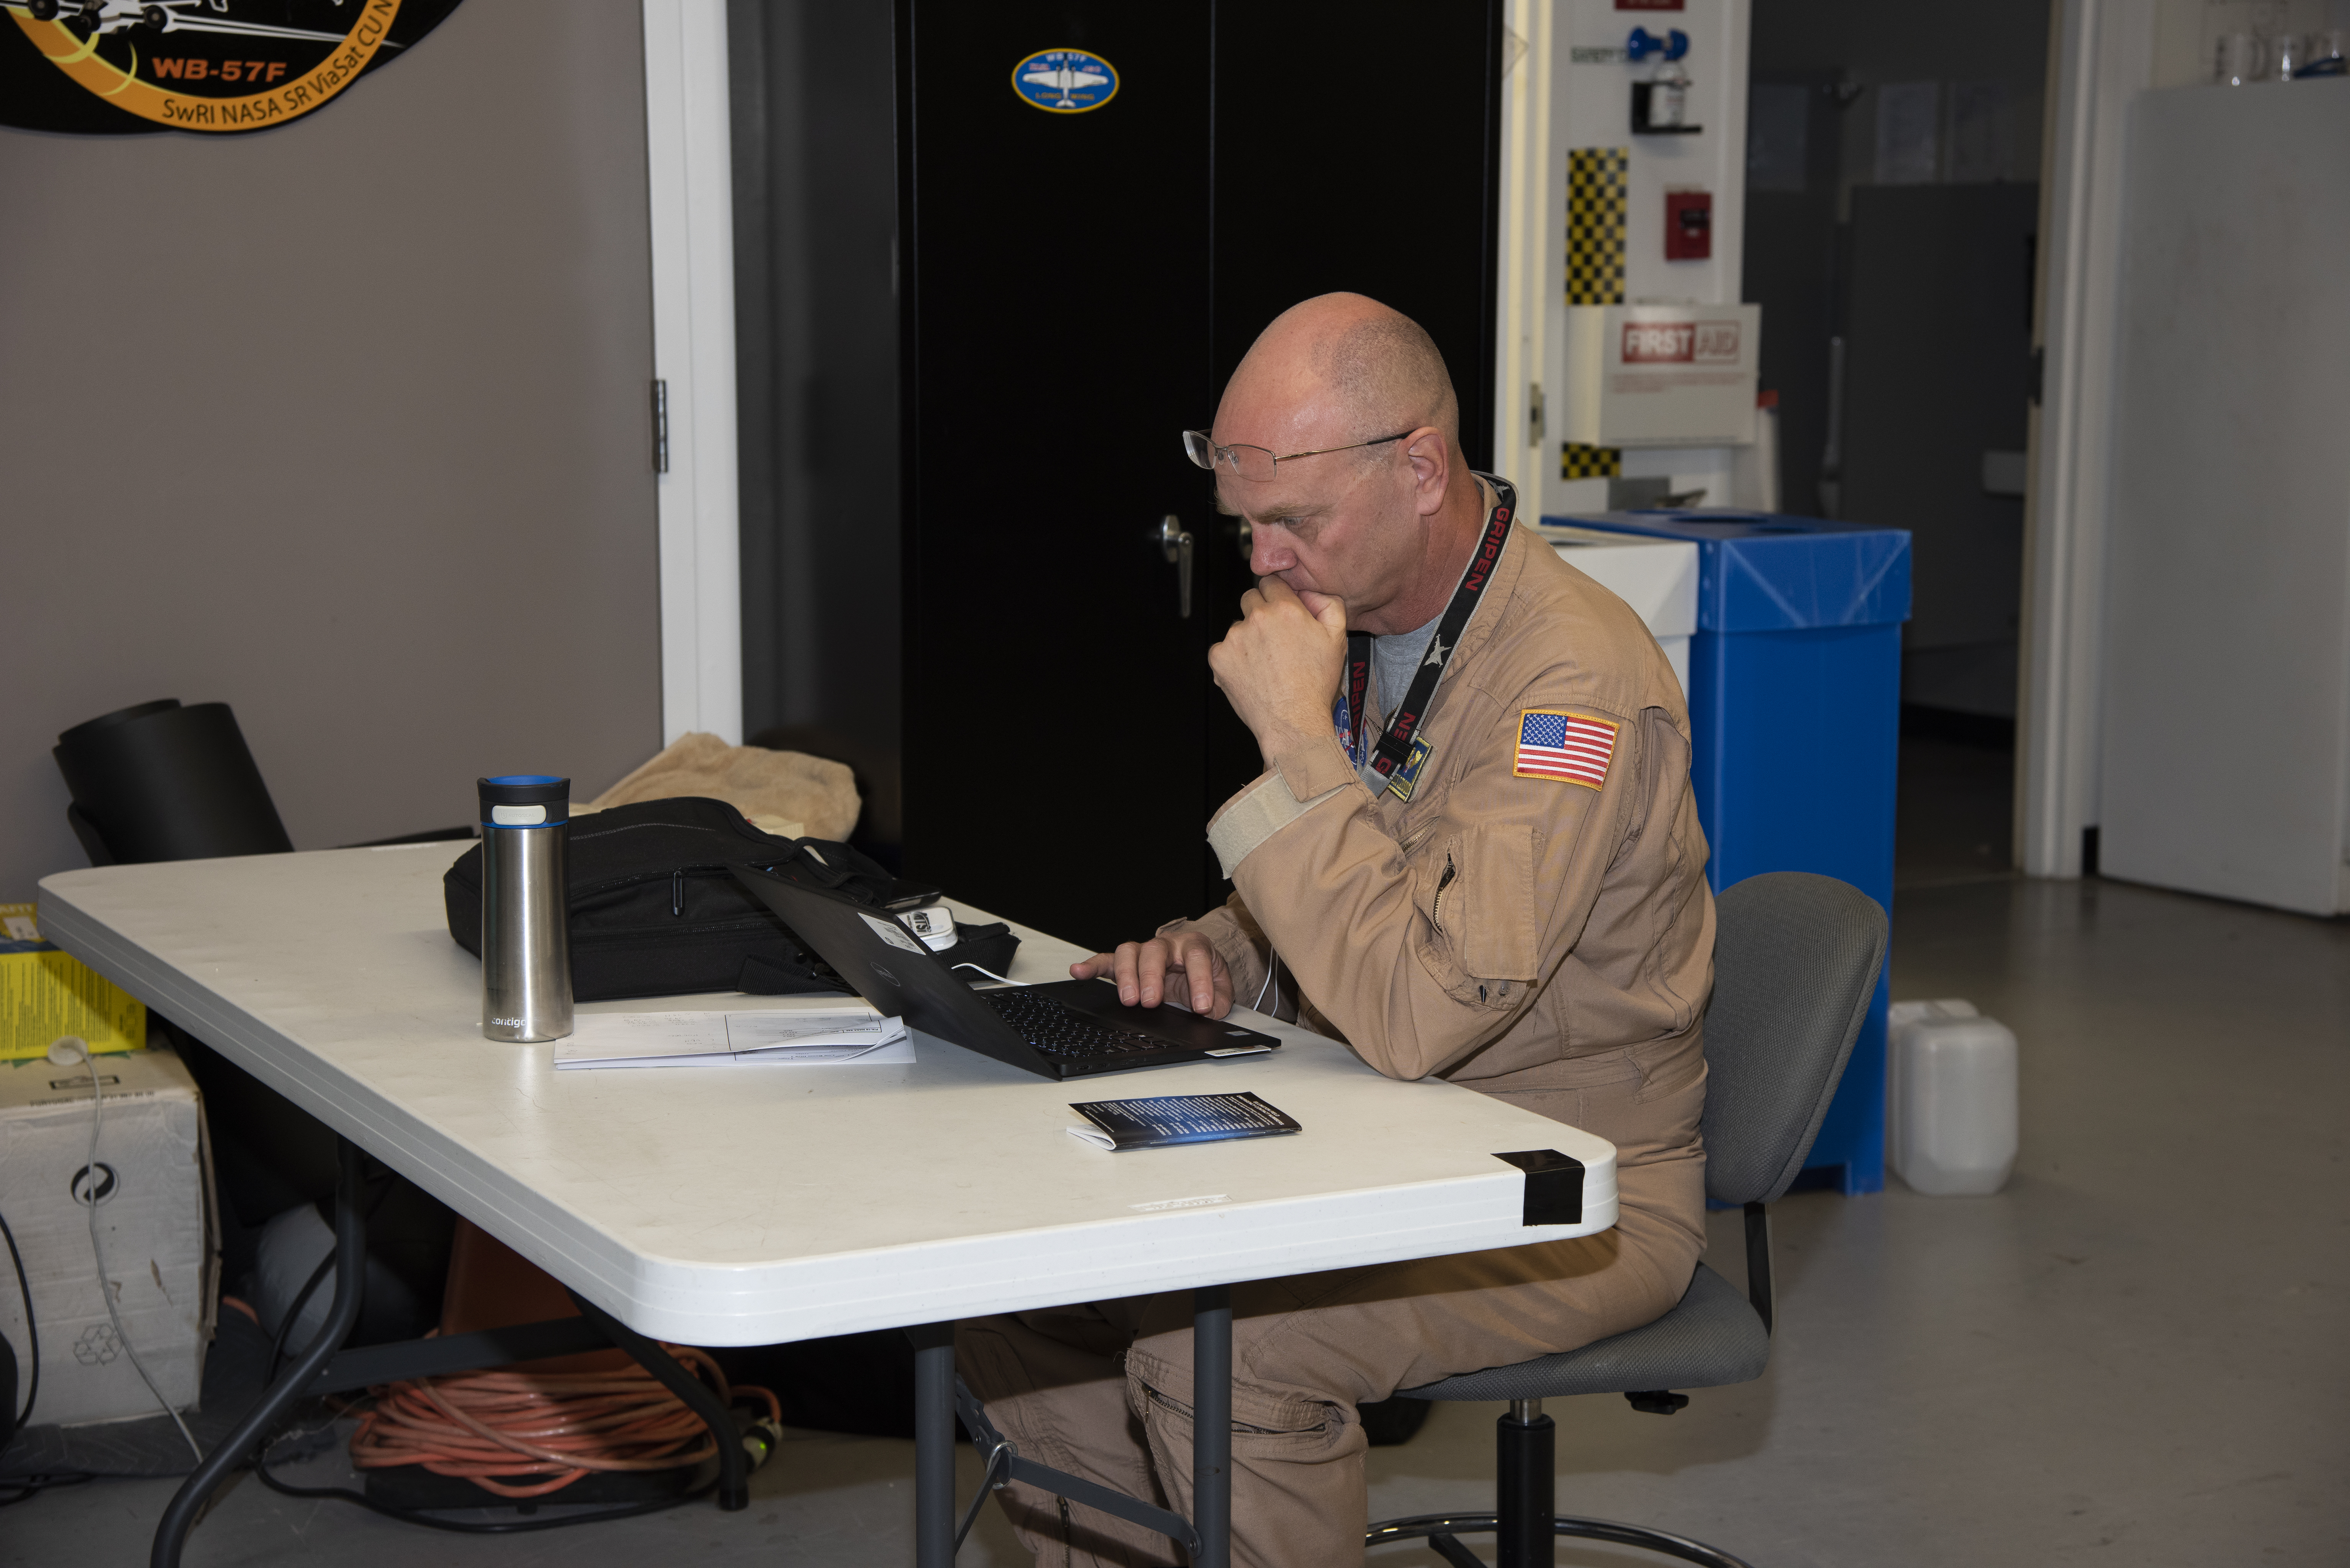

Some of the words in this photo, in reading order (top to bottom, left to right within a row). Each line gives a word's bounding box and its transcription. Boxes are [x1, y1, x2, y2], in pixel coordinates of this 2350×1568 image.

[152, 57, 287, 82] WB-57F
[162, 98, 215, 124] SwRI
[221, 98, 282, 124] NASA
[284, 85, 312, 110] SR
[308, 46, 364, 95] ViaSat
[358, 15, 382, 46] CU
[1625, 329, 1692, 356] FIRST
[1698, 329, 1738, 356] AID
[1465, 508, 1510, 591] GRIPEN
[1352, 662, 1365, 745] GRIPEN
[491, 1017, 527, 1028] contigo
[1254, 1106, 1270, 1114] CONTACT
[1268, 1114, 1284, 1125] NUMBERS
